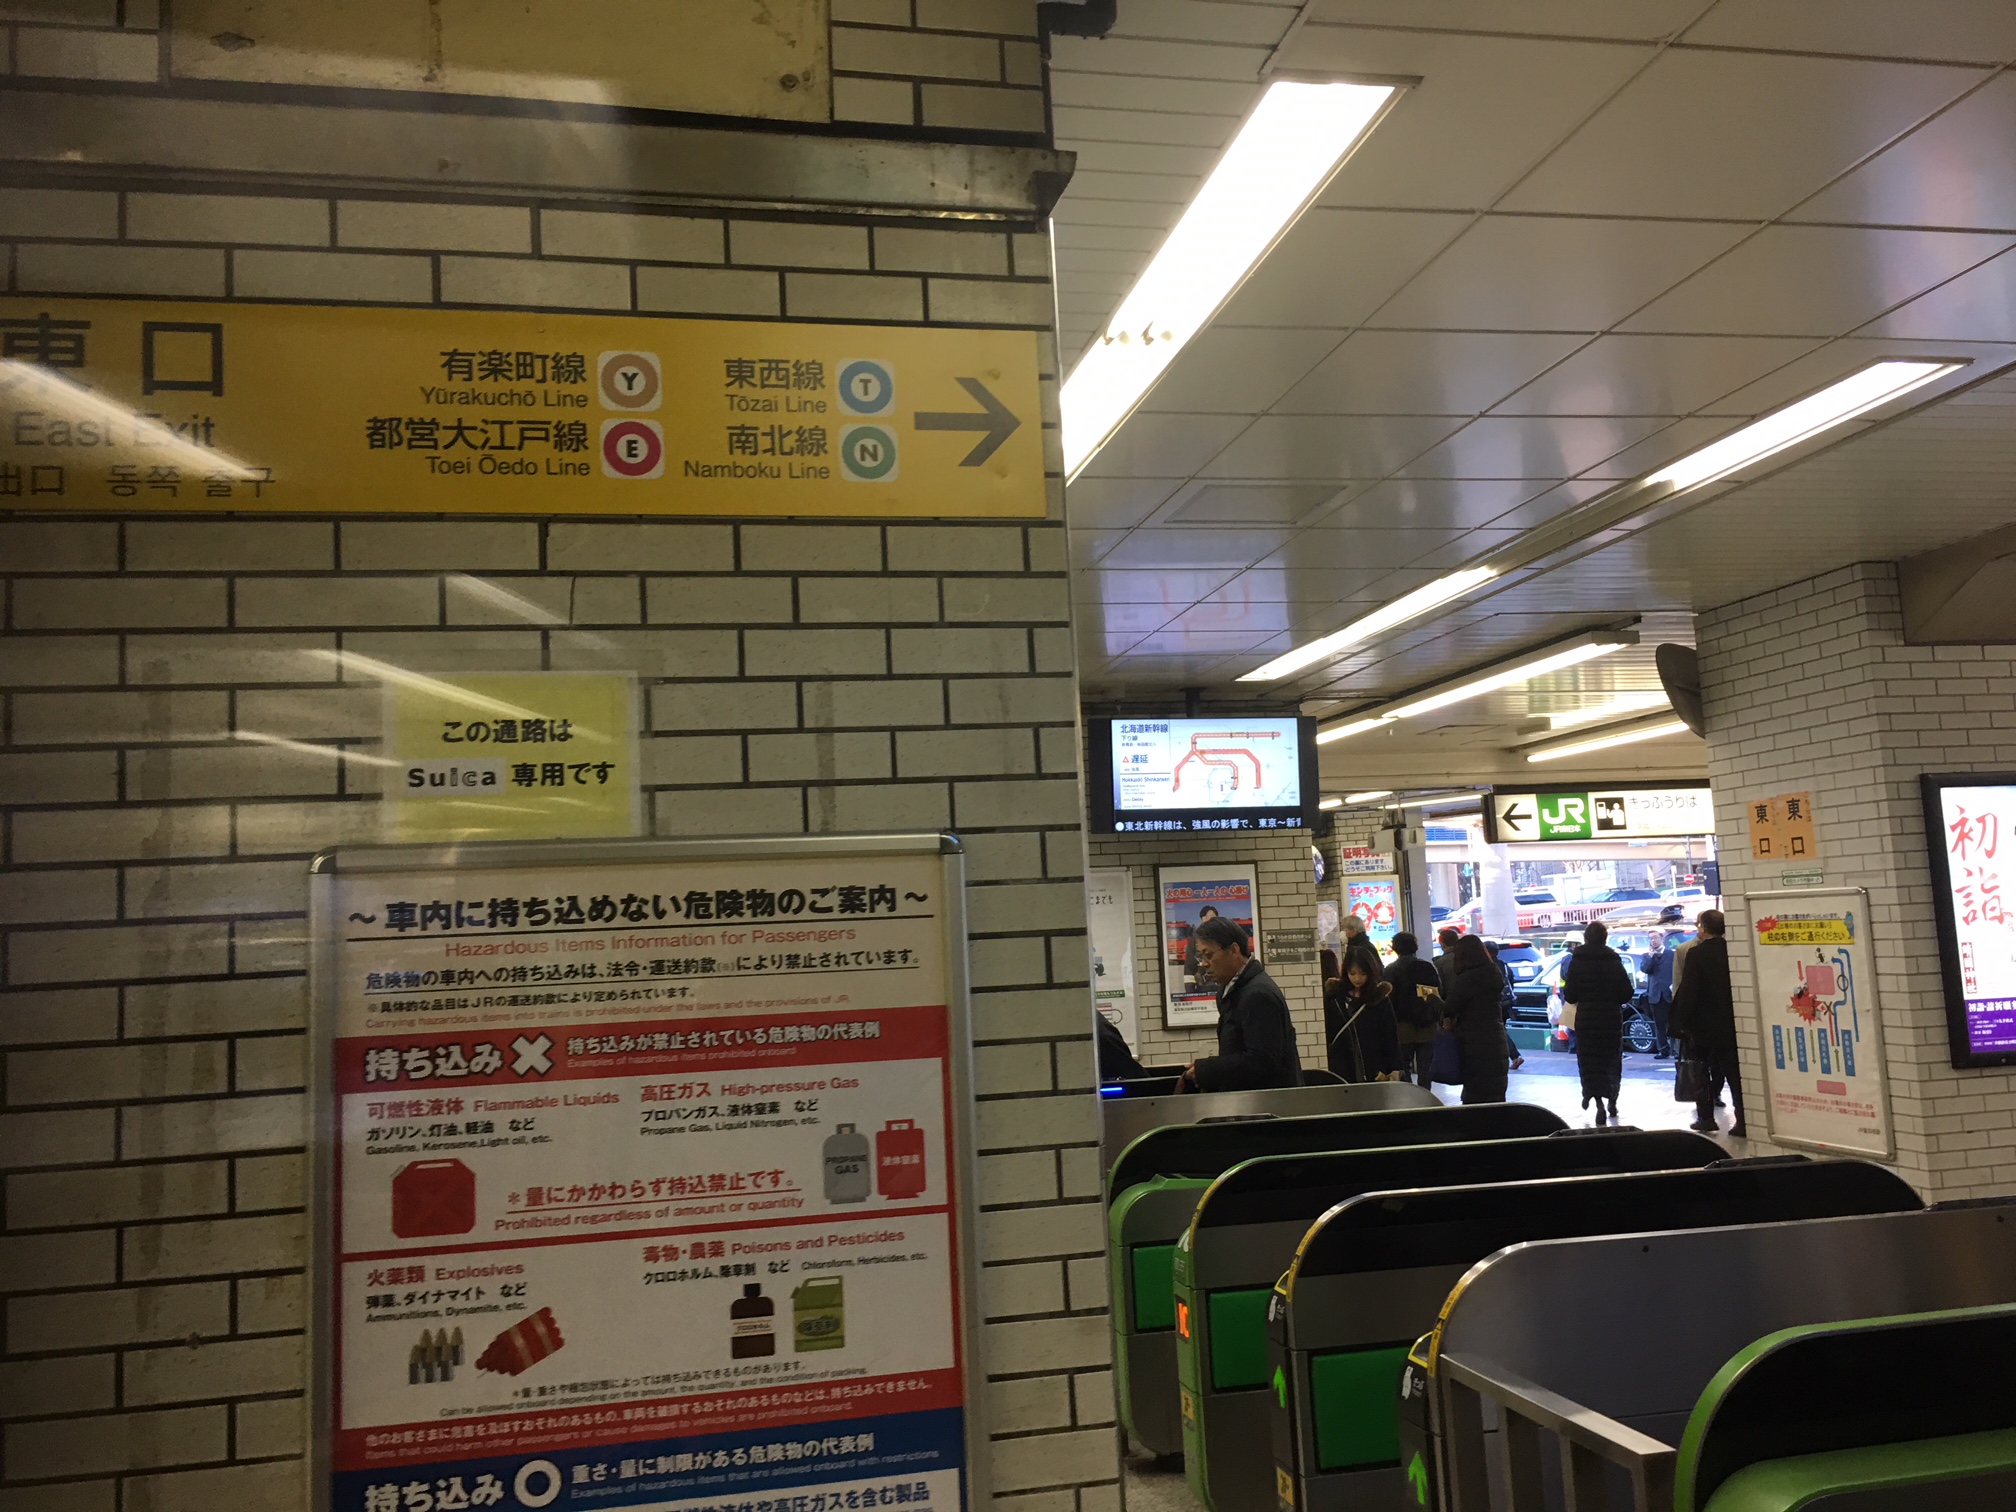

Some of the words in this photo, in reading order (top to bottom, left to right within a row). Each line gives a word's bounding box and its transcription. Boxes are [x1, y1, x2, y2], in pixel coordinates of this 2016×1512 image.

[0, 312, 225, 397] 東口
[440, 348, 588, 385] 有楽町線
[724, 358, 826, 391] 東西線
[622, 372, 639, 391] Y
[860, 379, 872, 396] T
[420, 386, 536, 408] Yūrakuchō
[543, 388, 589, 408] Line
[725, 393, 780, 413] Tōzai
[785, 394, 827, 414] Line
[13, 410, 116, 448] East
[133, 411, 216, 448] Exit
[366, 416, 589, 452] 都営大江戸線
[626, 440, 639, 458] E
[726, 425, 829, 457] 南北線
[860, 444, 878, 462] N
[425, 455, 471, 475] Toei
[478, 454, 538, 475] Ōedo
[546, 457, 591, 476] Line
[684, 460, 781, 480] Namboku
[788, 461, 830, 480] Line
[441, 718, 573, 743] この通路は
[1120, 724, 1168, 734] 北海道新幹線
[407, 767, 497, 788] Suica
[511, 761, 616, 787] 専用です
[1542, 798, 1587, 824] JR
[1755, 804, 1771, 854] 東口
[1786, 797, 1805, 855] 東口
[1949, 804, 2000, 926] 初詣
[445, 938, 548, 958] Hazardous
[555, 936, 605, 953] Items
[611, 931, 714, 950] Information
[721, 929, 746, 945] for
[752, 925, 856, 945] Passengers
[566, 1020, 880, 1055] 持ち込みが禁止されている危険物の代表例
[365, 1041, 502, 1082] 持ち込み
[640, 1081, 711, 1102] 高圧ガス
[720, 1077, 825, 1098] High-pressure
[830, 1075, 859, 1091] Gas
[366, 1097, 463, 1120] 可燃性液体
[473, 1094, 558, 1113] Flammable
[563, 1090, 620, 1107] Liquids
[793, 1098, 818, 1112] など
[508, 1117, 535, 1132] など
[834, 1164, 859, 1174] GAS
[494, 1214, 571, 1231] Prohibited
[574, 1207, 651, 1225] regardless
[655, 1206, 669, 1218] of
[673, 1202, 724, 1217] amount
[729, 1200, 743, 1213] or
[747, 1195, 804, 1211] quantity
[731, 1238, 791, 1255] Poisons
[795, 1235, 823, 1250] and
[827, 1228, 905, 1247] Pesticides
[435, 1260, 524, 1281] Explosives
[767, 1259, 790, 1275] など
[500, 1281, 526, 1298] など
[364, 1471, 504, 1512] 持ち込み
